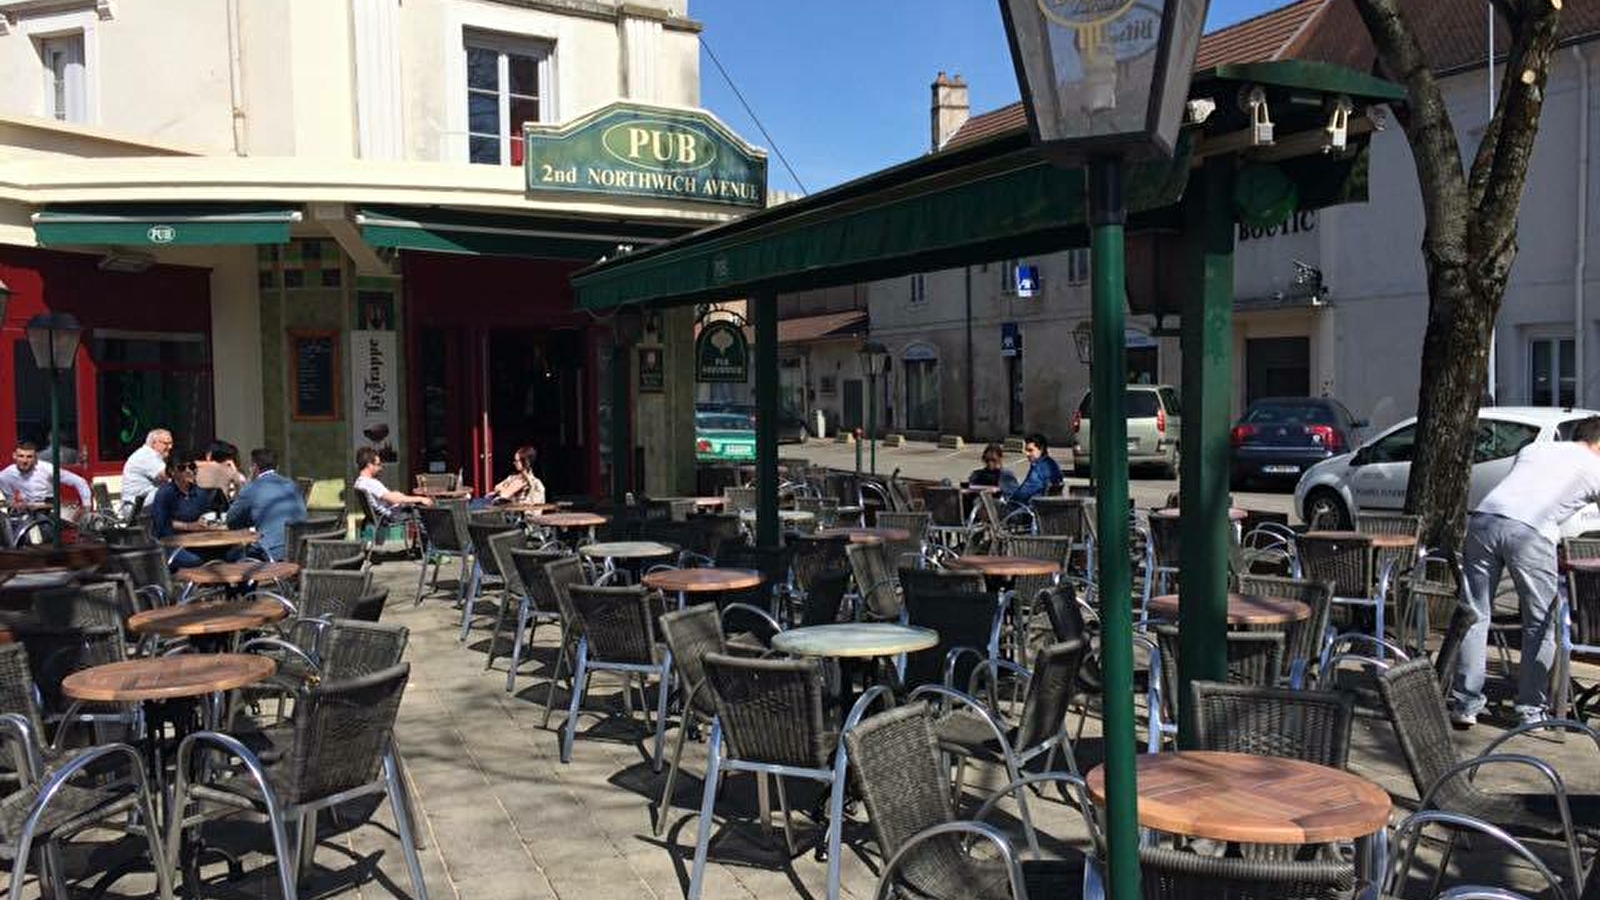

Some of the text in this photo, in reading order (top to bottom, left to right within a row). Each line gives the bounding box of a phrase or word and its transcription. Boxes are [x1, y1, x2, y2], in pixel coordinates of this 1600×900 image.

[628, 127, 697, 164] PUB
[541, 164, 759, 200] 2nd NORTHWICH AVENUE
[151, 228, 171, 241] PUB
